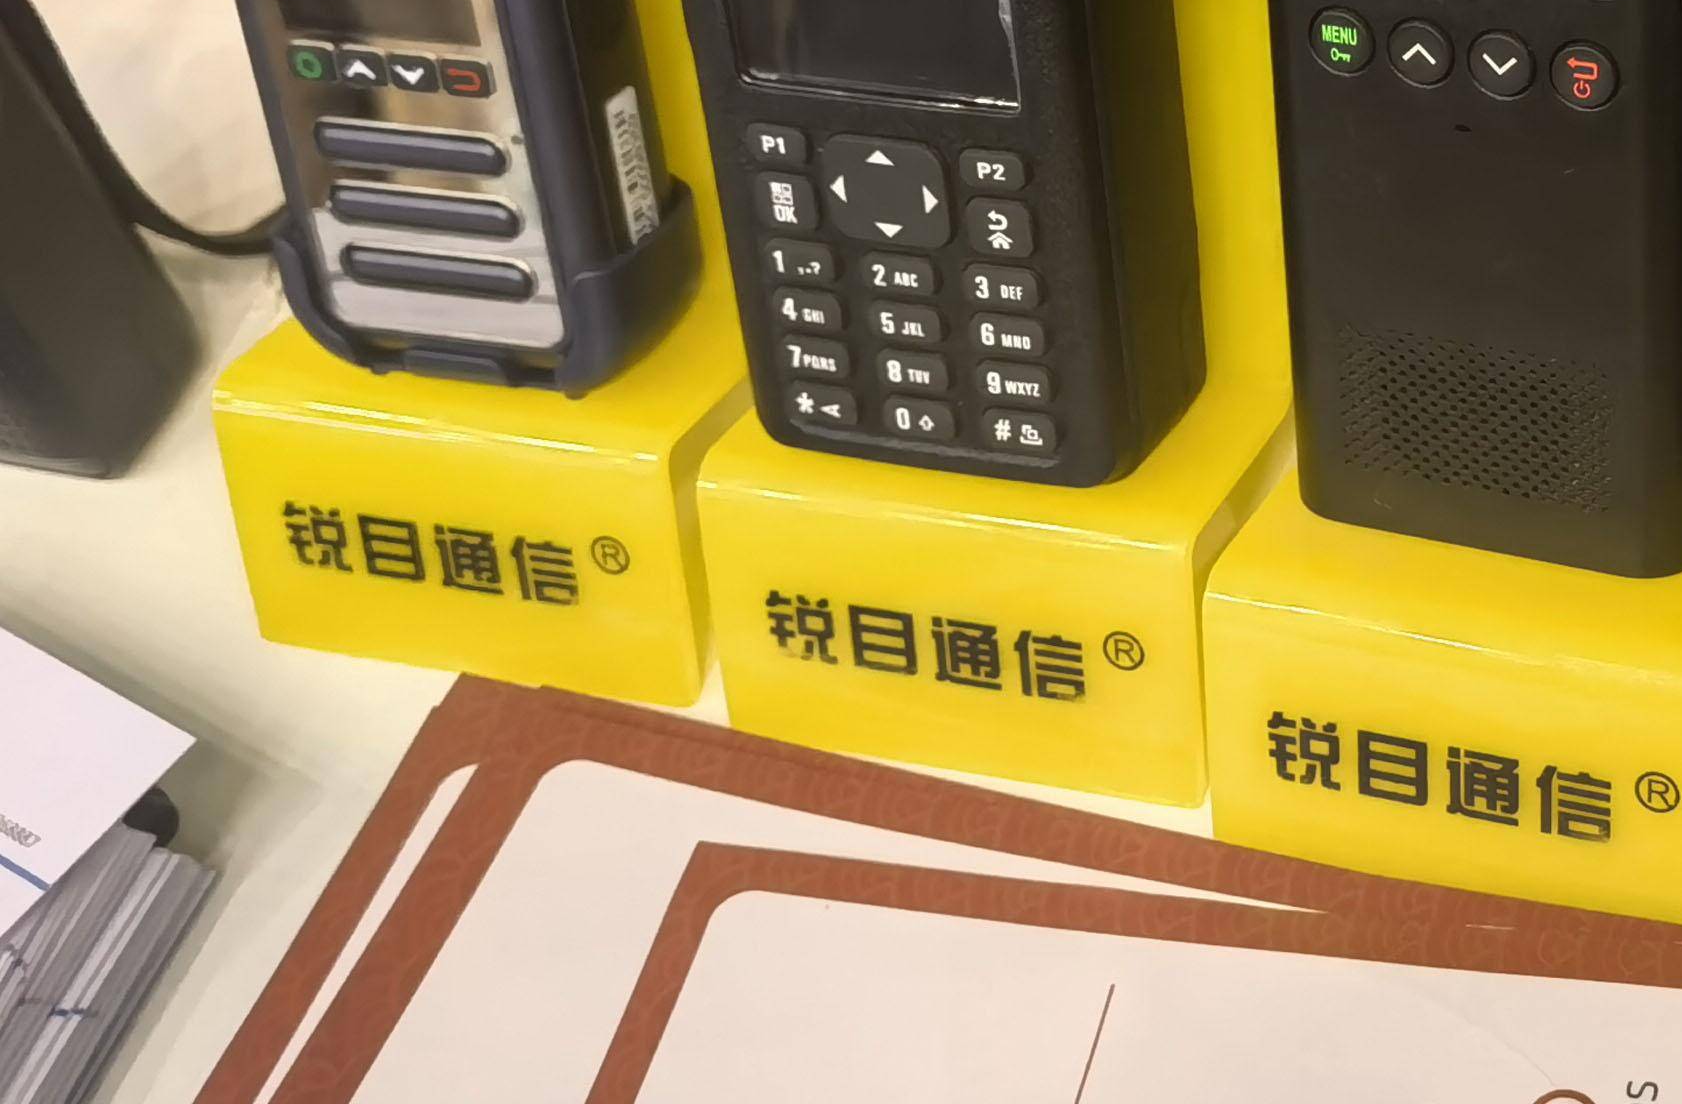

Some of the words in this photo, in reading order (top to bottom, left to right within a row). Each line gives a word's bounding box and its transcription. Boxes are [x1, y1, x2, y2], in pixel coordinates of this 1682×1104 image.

[1320, 23, 1358, 46] MENU
[761, 134, 786, 154] P1
[976, 161, 1007, 181] P2
[773, 204, 798, 224] OK
[772, 250, 785, 274] 1
[871, 263, 887, 287] 2
[894, 271, 919, 288] ABC
[974, 275, 990, 299] 3
[1000, 284, 1023, 301] DEF
[782, 297, 798, 321] 4
[880, 311, 896, 334] 5
[901, 320, 925, 337] JKL
[980, 322, 995, 346] 6
[1000, 333, 1032, 351] MNO
[786, 344, 801, 368] 7
[886, 359, 903, 383] 8
[986, 371, 1002, 394] 9
[1004, 380, 1041, 398] WXYZ
[895, 407, 911, 430] 0
[281, 500, 580, 606] 锐目通信
[765, 589, 1087, 702] 锐目通信
[1267, 710, 1613, 844] 锐目通信
